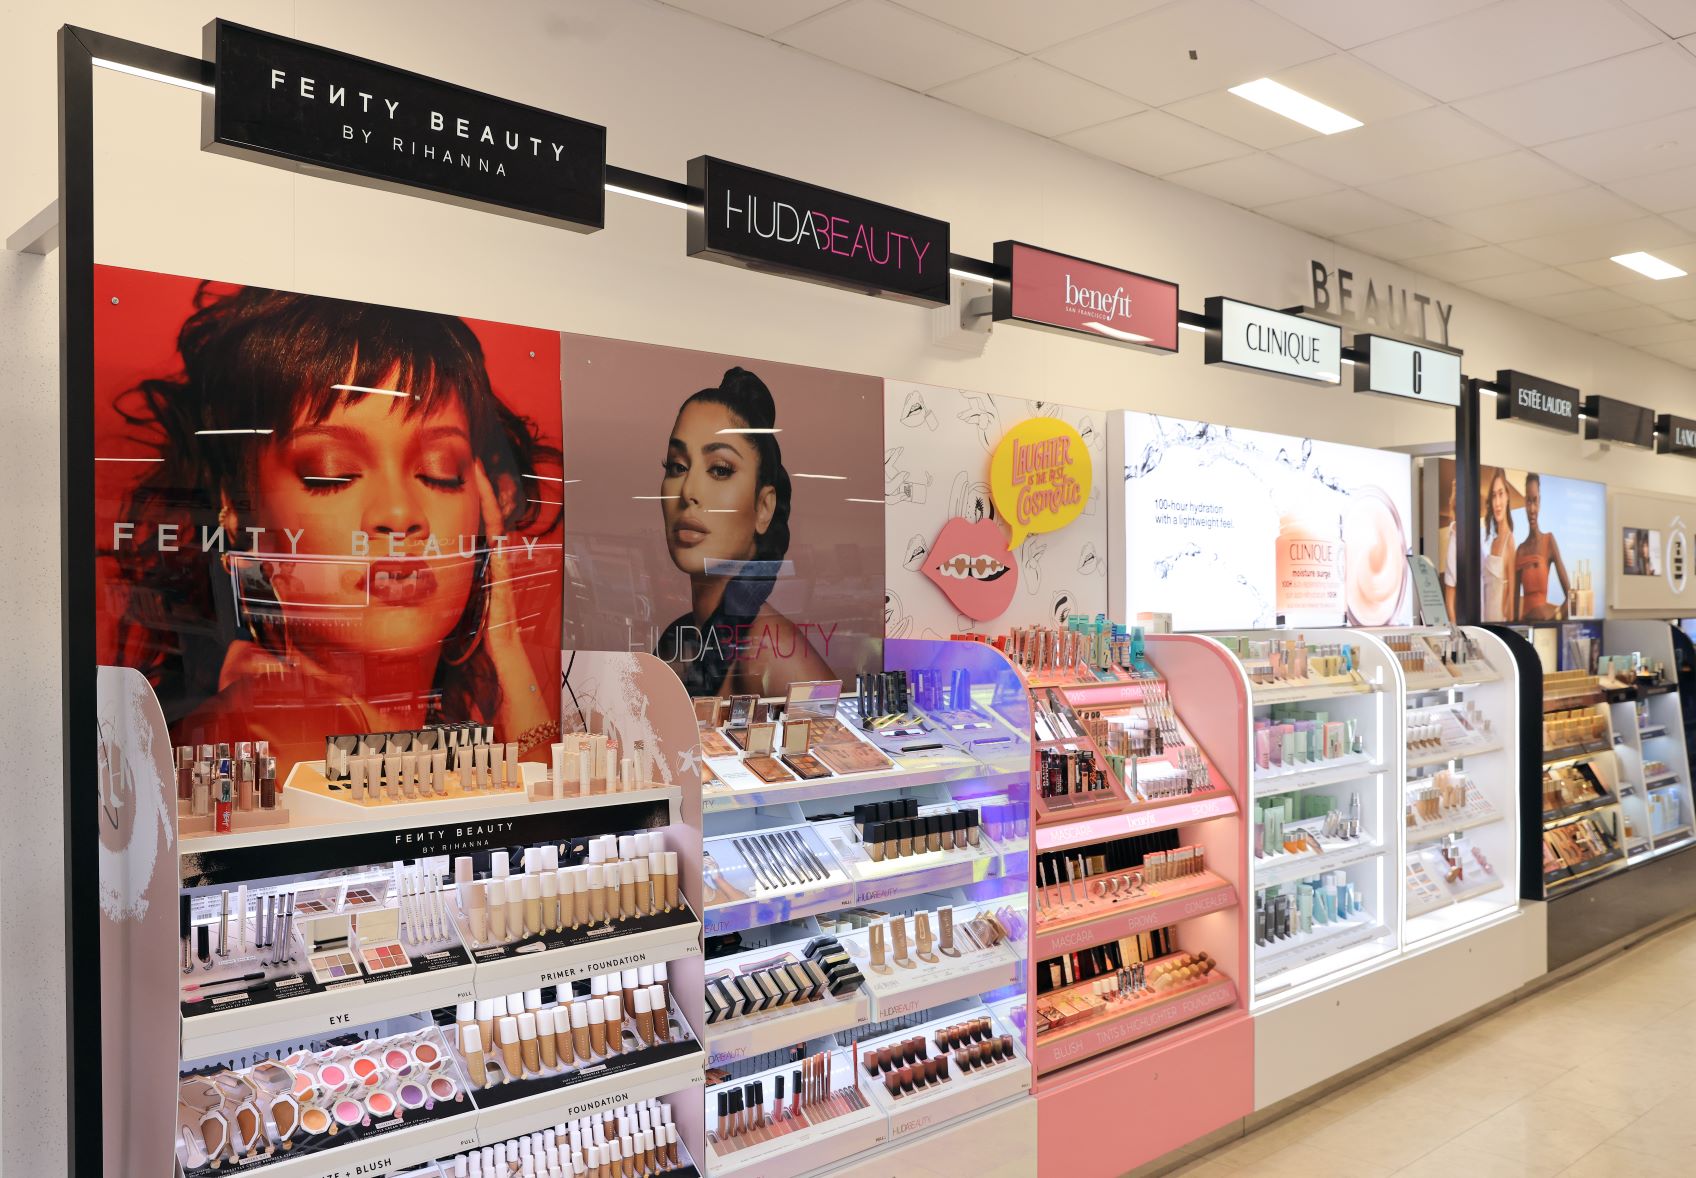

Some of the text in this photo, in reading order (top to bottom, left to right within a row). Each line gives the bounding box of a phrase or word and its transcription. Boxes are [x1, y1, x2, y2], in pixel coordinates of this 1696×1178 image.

[271, 69, 565, 162] FENTY BEAUTY
[342, 124, 508, 177] BY RIHANNA
[1065, 274, 1133, 321] benefit
[1311, 260, 1453, 347] BEAUTY
[1078, 309, 1108, 320] FRANCISCO
[1246, 323, 1320, 364] CLINIQUE
[1542, 395, 1572, 417] LAUDER
[1012, 435, 1073, 486] LAUGHTER
[1155, 498, 1223, 514] 100-hour hydration
[1156, 514, 1171, 525] with
[1173, 516, 1178, 525] a
[1179, 516, 1218, 529] lightweight
[113, 523, 541, 560] FENTY BEAUTY
[1290, 543, 1333, 563] CLINIQUE
[1127, 813, 1157, 830] benefit
[395, 822, 514, 844] FENTY BEAUTY
[1050, 825, 1093, 842] MASCARA
[422, 839, 490, 854] BY RIHANNA
[1185, 895, 1228, 914] CONCEALER
[1128, 913, 1158, 929] BROWS
[1051, 930, 1094, 950] MASCARA
[541, 970, 575, 982] PRIMER
[587, 953, 647, 972] FOUNDATION
[1183, 989, 1230, 1011] FOUNDATION
[329, 1013, 351, 1025] EYE
[1096, 1028, 1120, 1044] TINTS
[1126, 1007, 1178, 1033] HIGHLIGHTER
[1054, 1041, 1084, 1060] BLUSH
[568, 1093, 629, 1115] FOUNDATION
[355, 1158, 392, 1175] BLUSH
